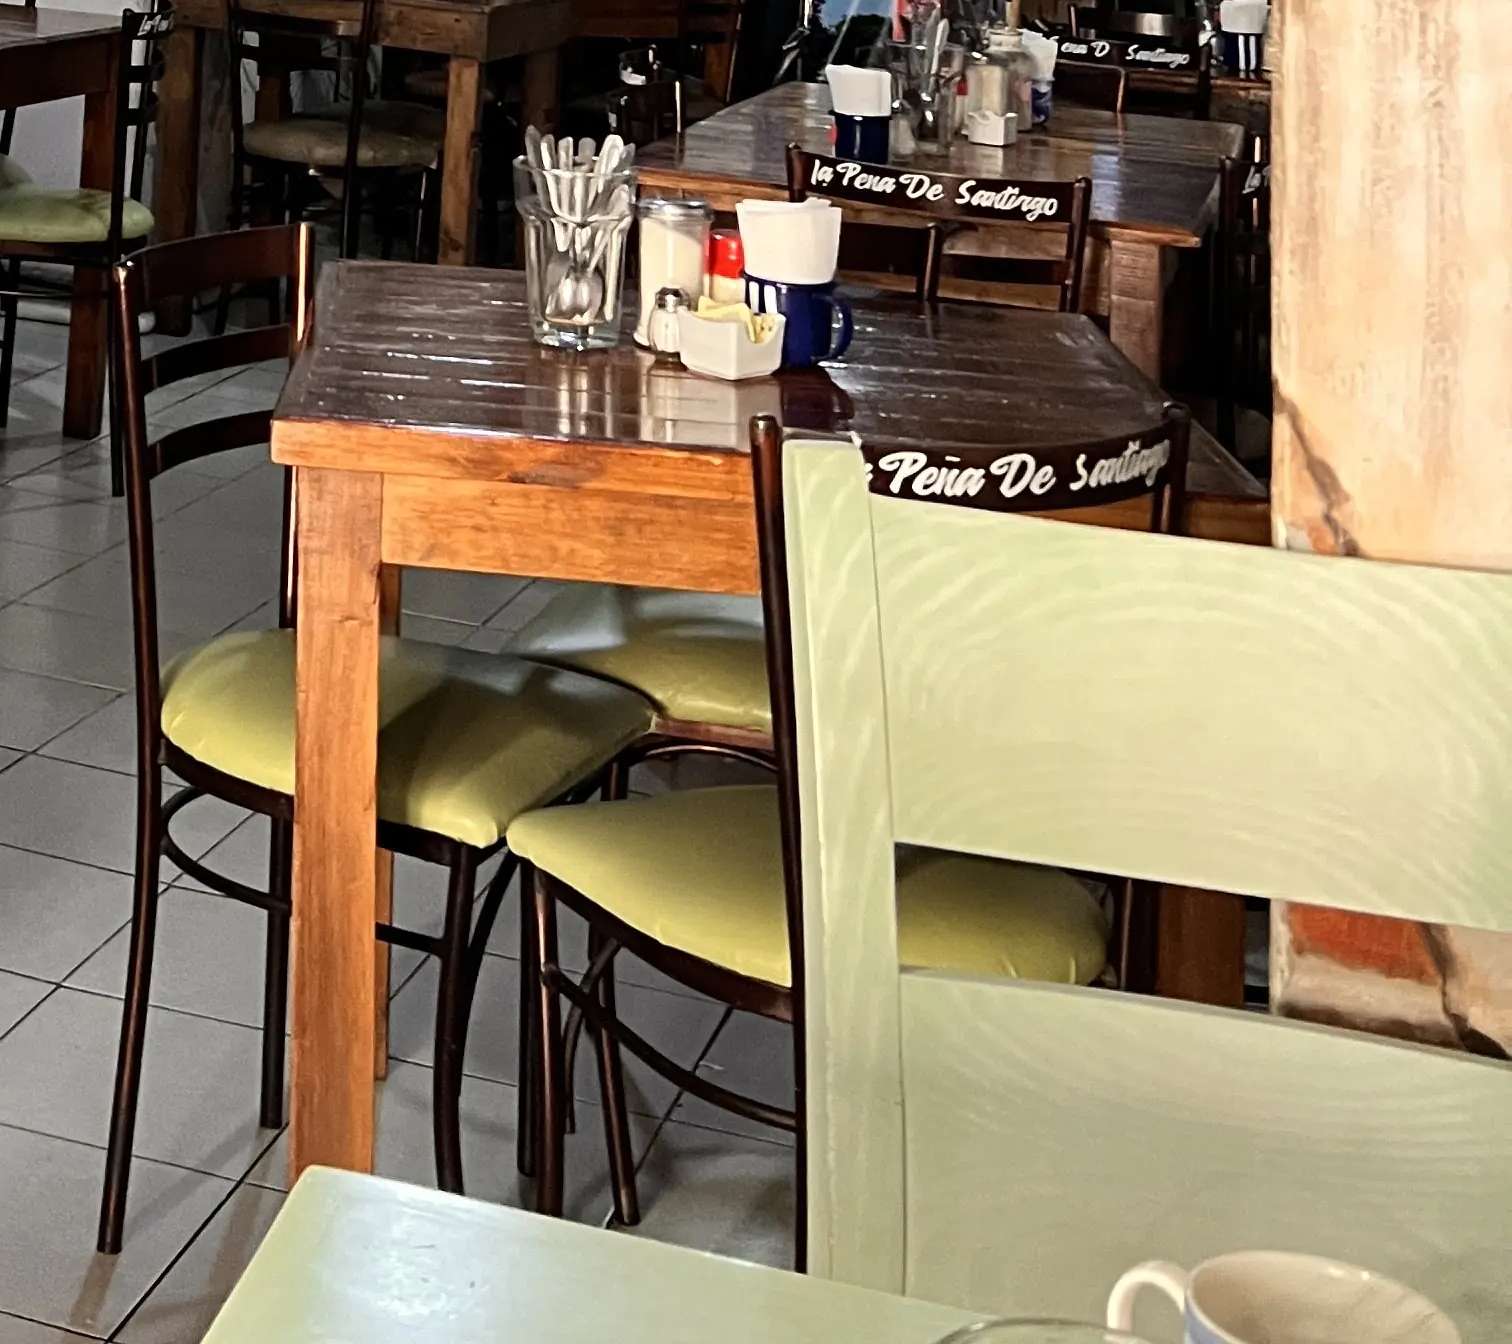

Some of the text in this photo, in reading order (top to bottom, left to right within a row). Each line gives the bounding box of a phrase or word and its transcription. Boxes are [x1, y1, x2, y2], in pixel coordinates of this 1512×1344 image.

[899, 174, 945, 201] De
[955, 179, 1059, 222] Santiago
[877, 450, 987, 498] Peña
[989, 453, 1058, 499] De
